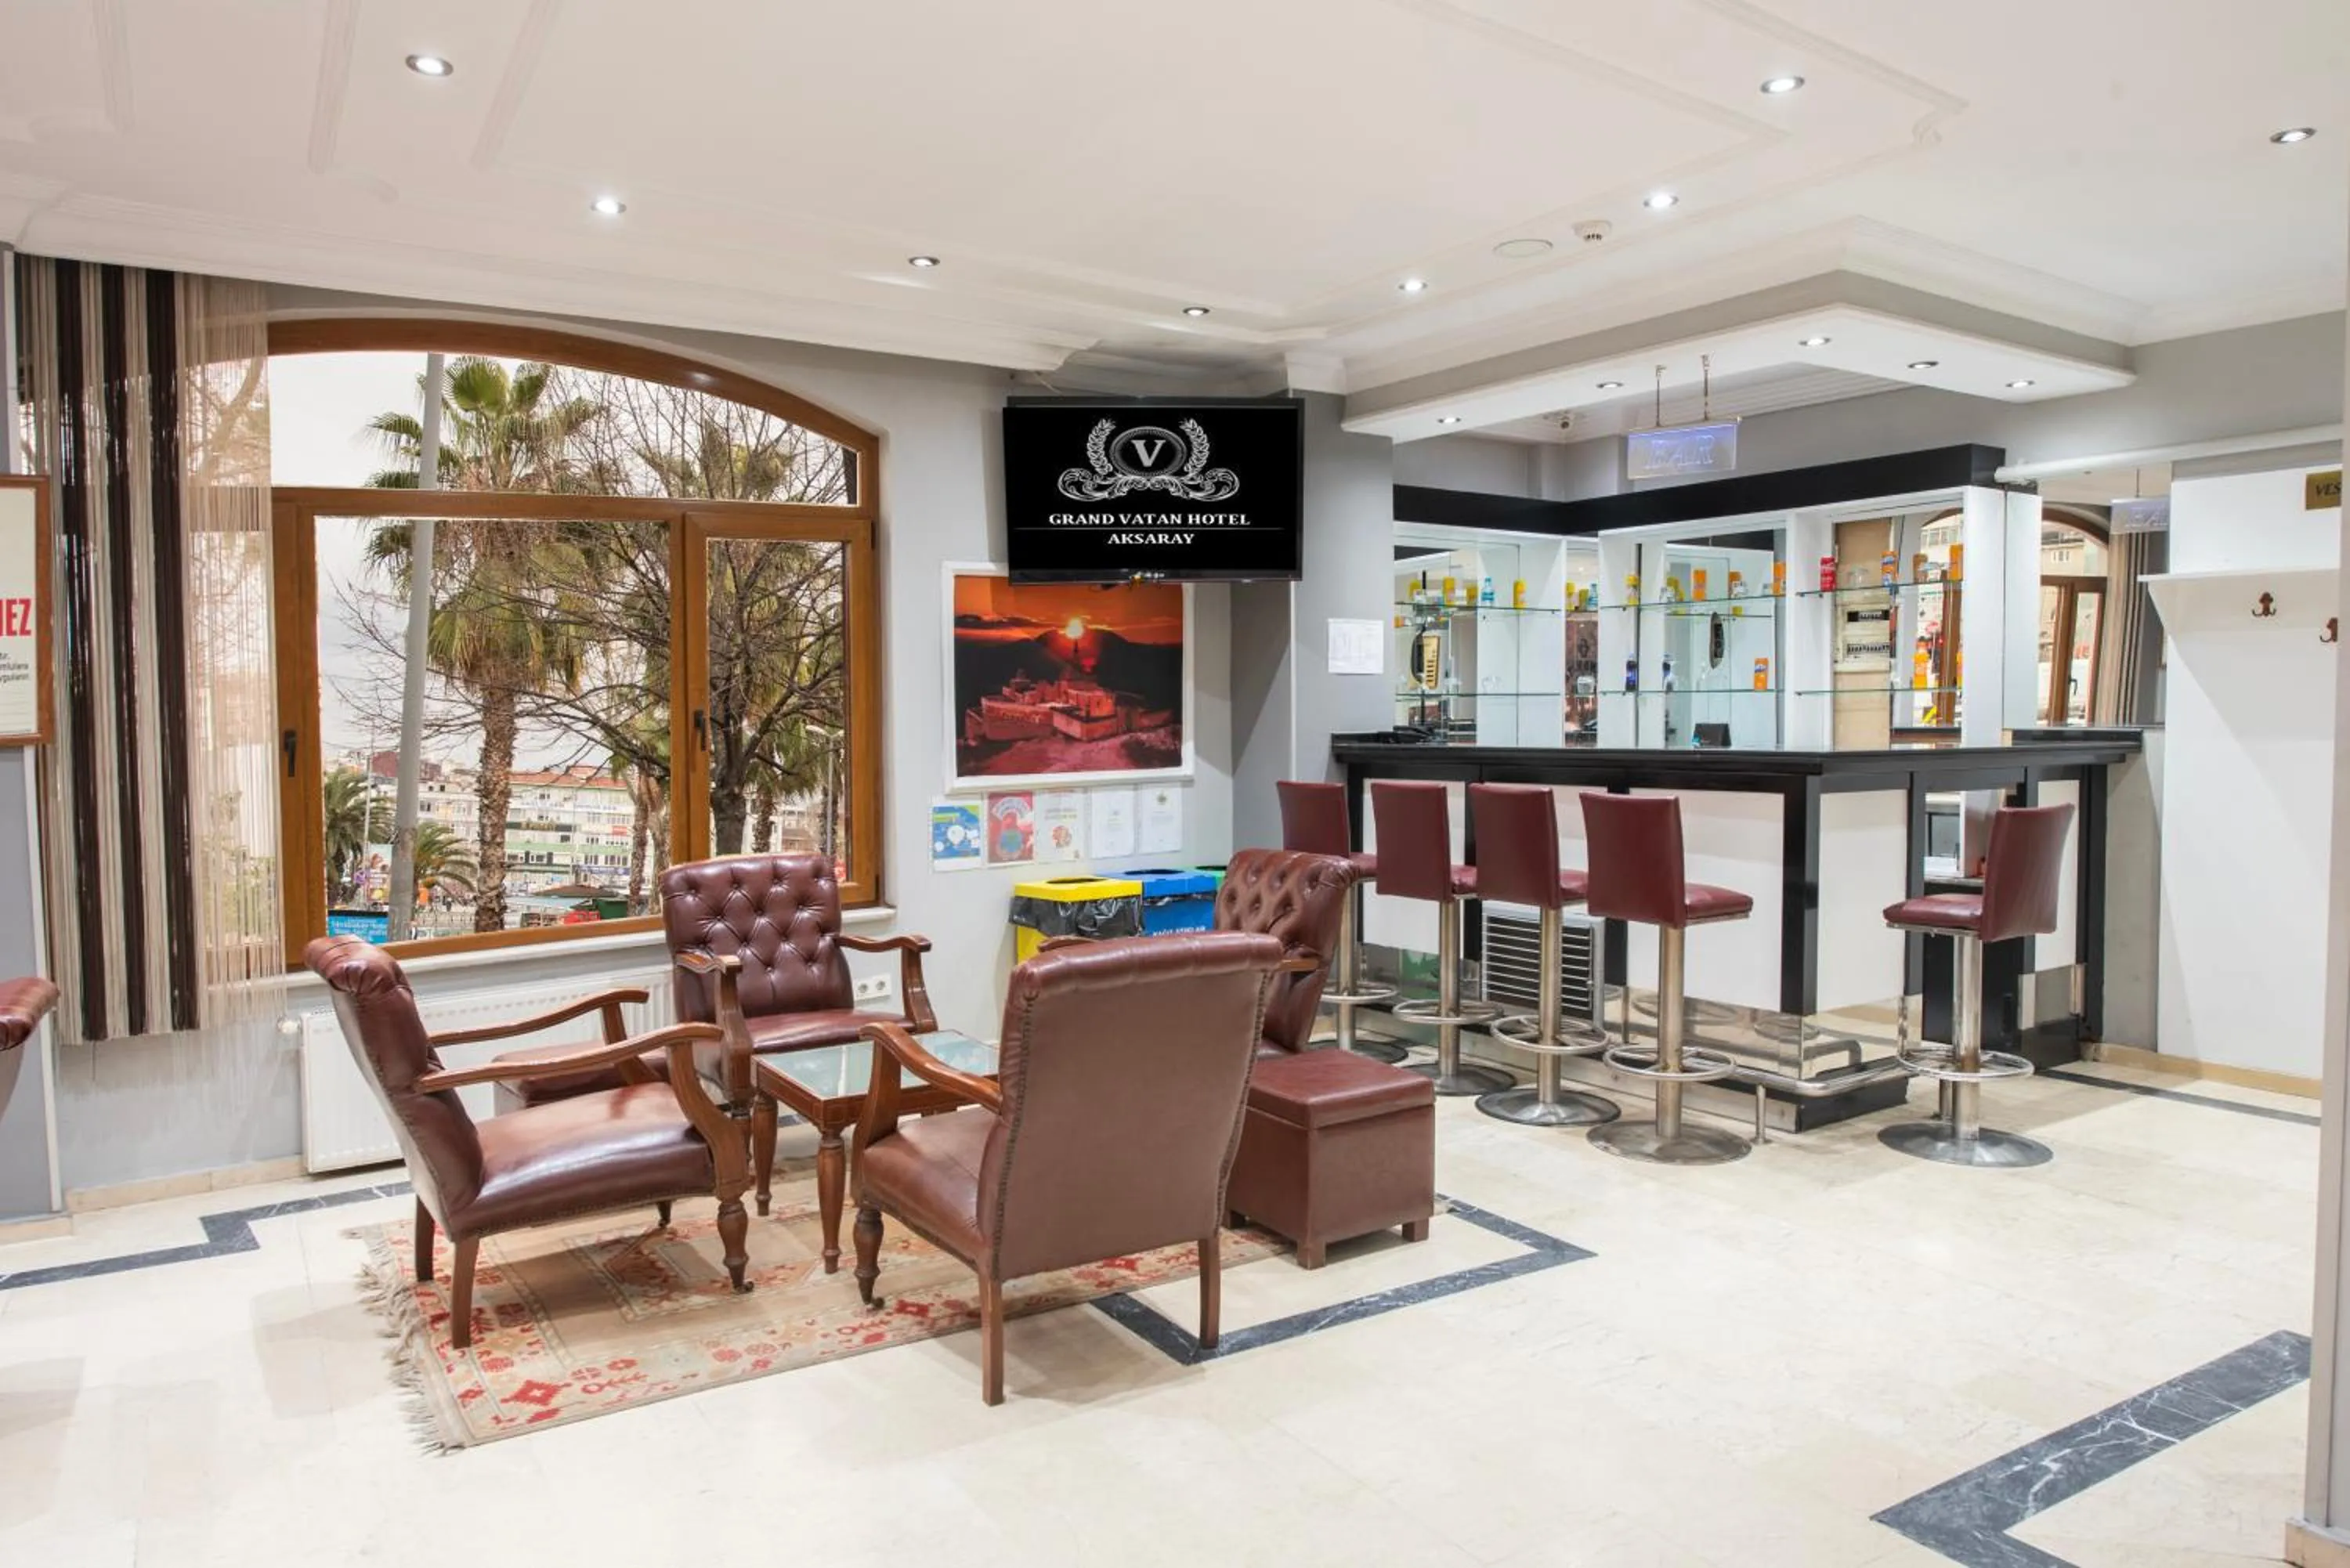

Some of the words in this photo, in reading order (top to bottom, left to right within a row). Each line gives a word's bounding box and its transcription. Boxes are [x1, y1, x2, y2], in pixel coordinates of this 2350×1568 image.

[1131, 439, 1166, 467] V
[1049, 513, 1115, 525] GRAND
[1119, 513, 1182, 525] VATAN
[1188, 513, 1250, 526] HOTEL
[1107, 533, 1195, 545] AKSARAY
